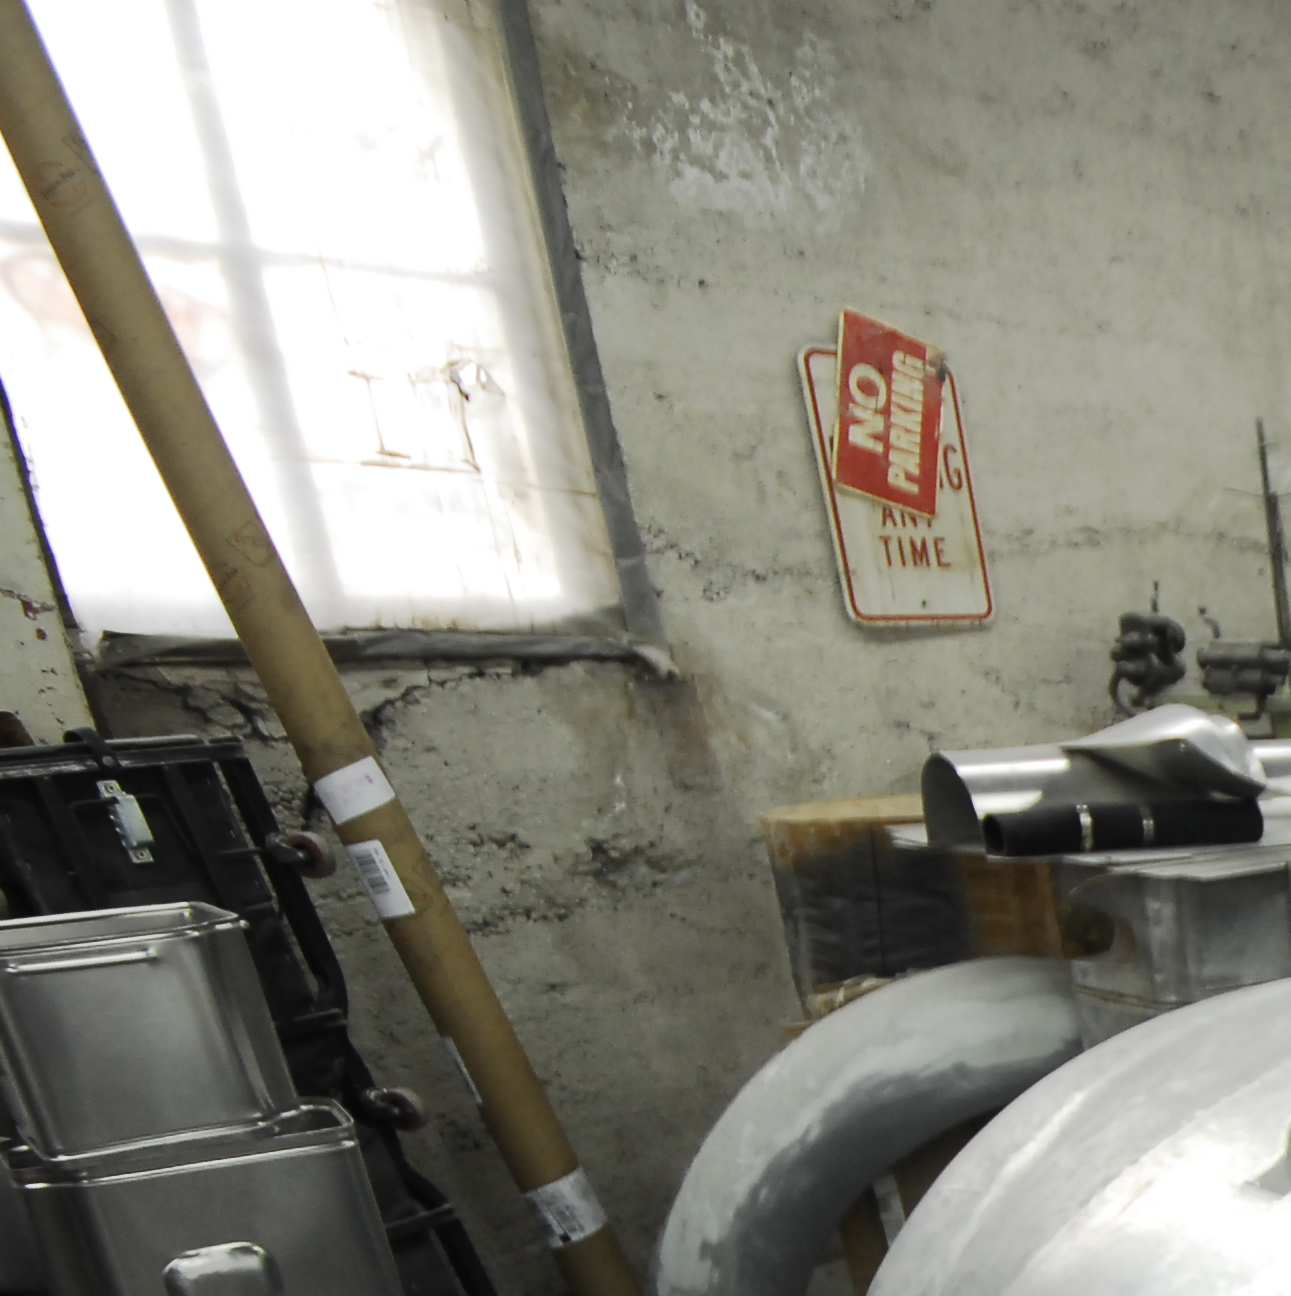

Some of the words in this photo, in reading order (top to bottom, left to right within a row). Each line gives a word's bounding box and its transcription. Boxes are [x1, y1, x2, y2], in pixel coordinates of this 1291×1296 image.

[848, 362, 888, 454] NO
[887, 349, 925, 496] PARKING
[878, 535, 952, 568] TIME
